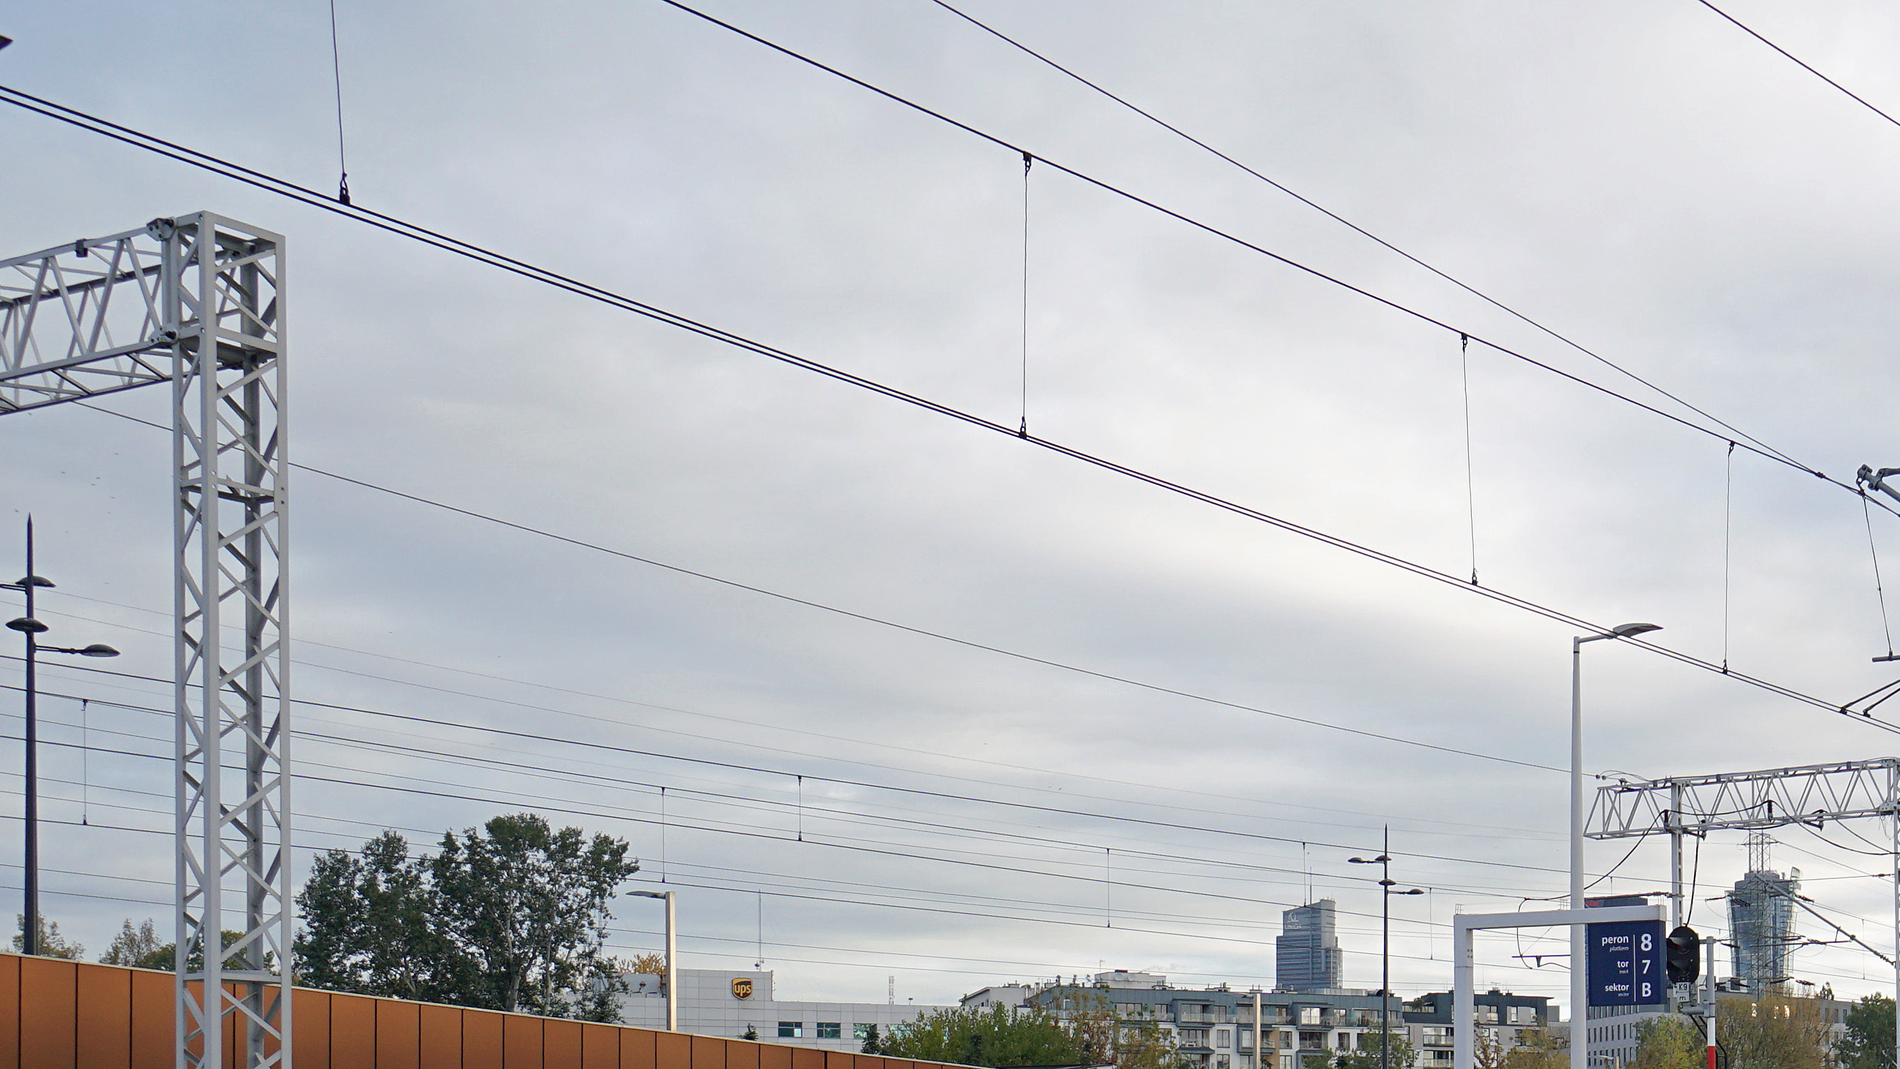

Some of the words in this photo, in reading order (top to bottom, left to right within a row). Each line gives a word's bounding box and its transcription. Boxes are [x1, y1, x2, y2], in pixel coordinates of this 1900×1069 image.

[1602, 936, 1628, 946] peron
[1641, 934, 1652, 951] 8
[1642, 960, 1651, 974] 7
[734, 984, 751, 996] ups
[1605, 983, 1629, 991] sektor
[1642, 982, 1651, 997] B
